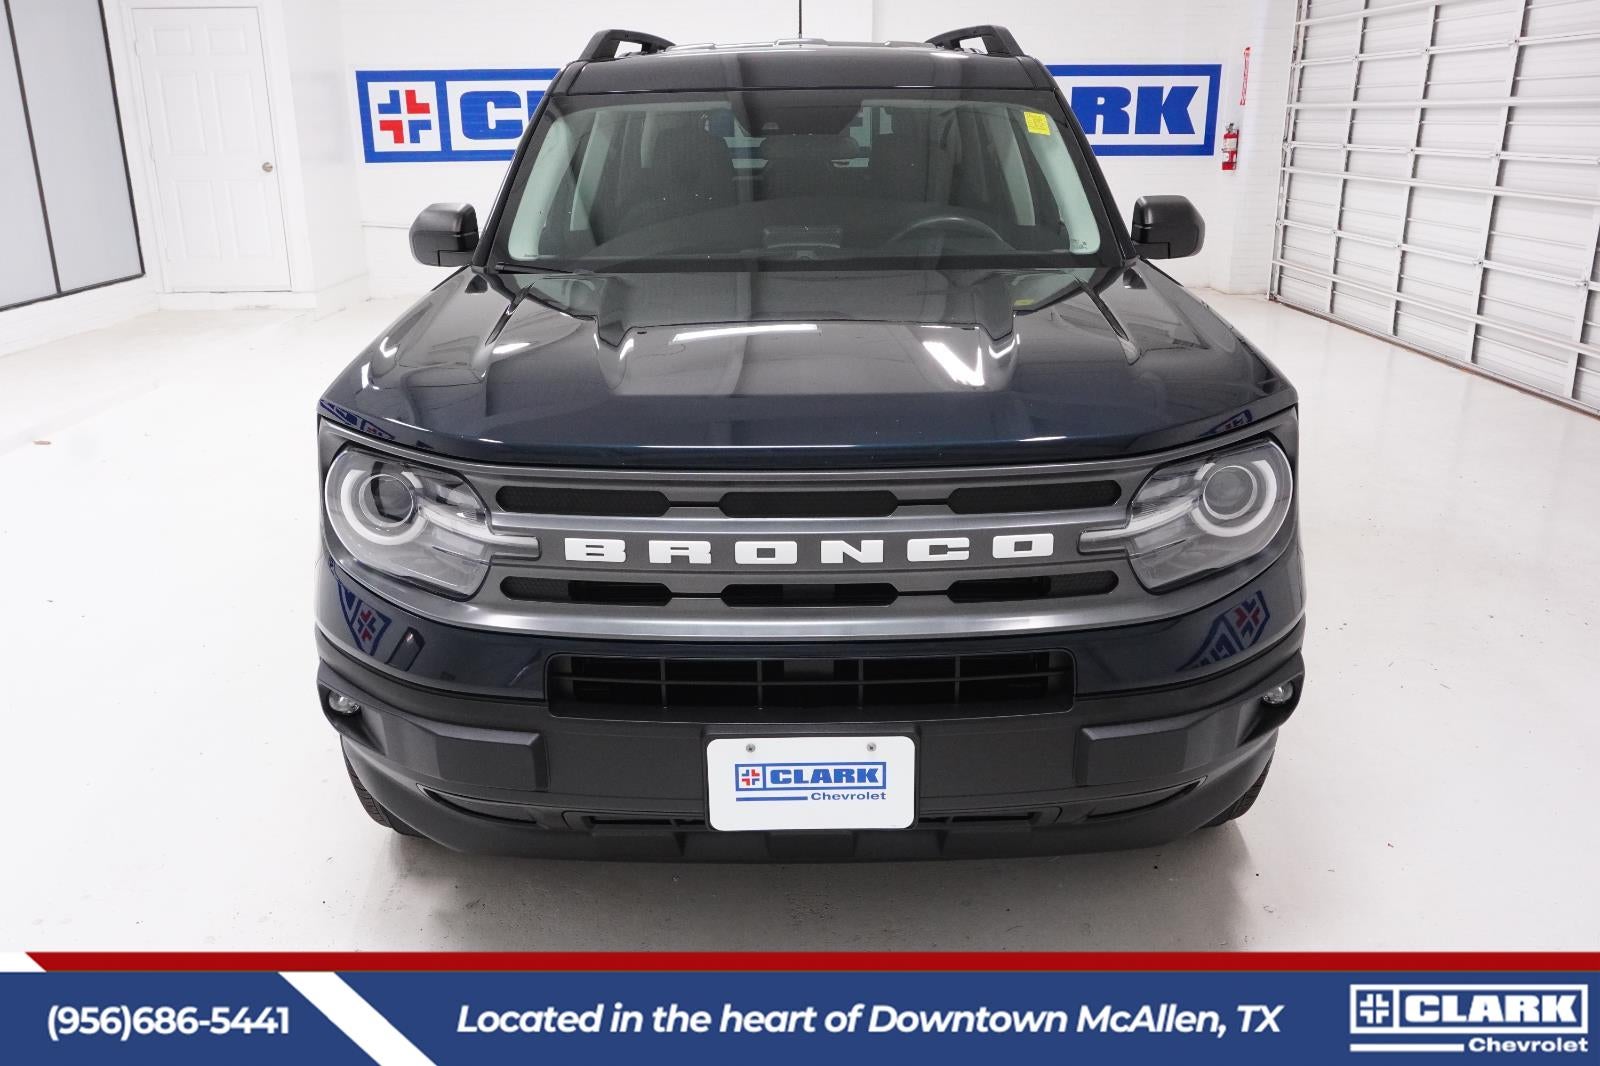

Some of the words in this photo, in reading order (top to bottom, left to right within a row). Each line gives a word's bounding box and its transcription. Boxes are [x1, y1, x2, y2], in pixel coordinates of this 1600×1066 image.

[564, 533, 1054, 565] BRONCO
[770, 768, 879, 784] CLARK
[810, 792, 887, 801] Chevrolet
